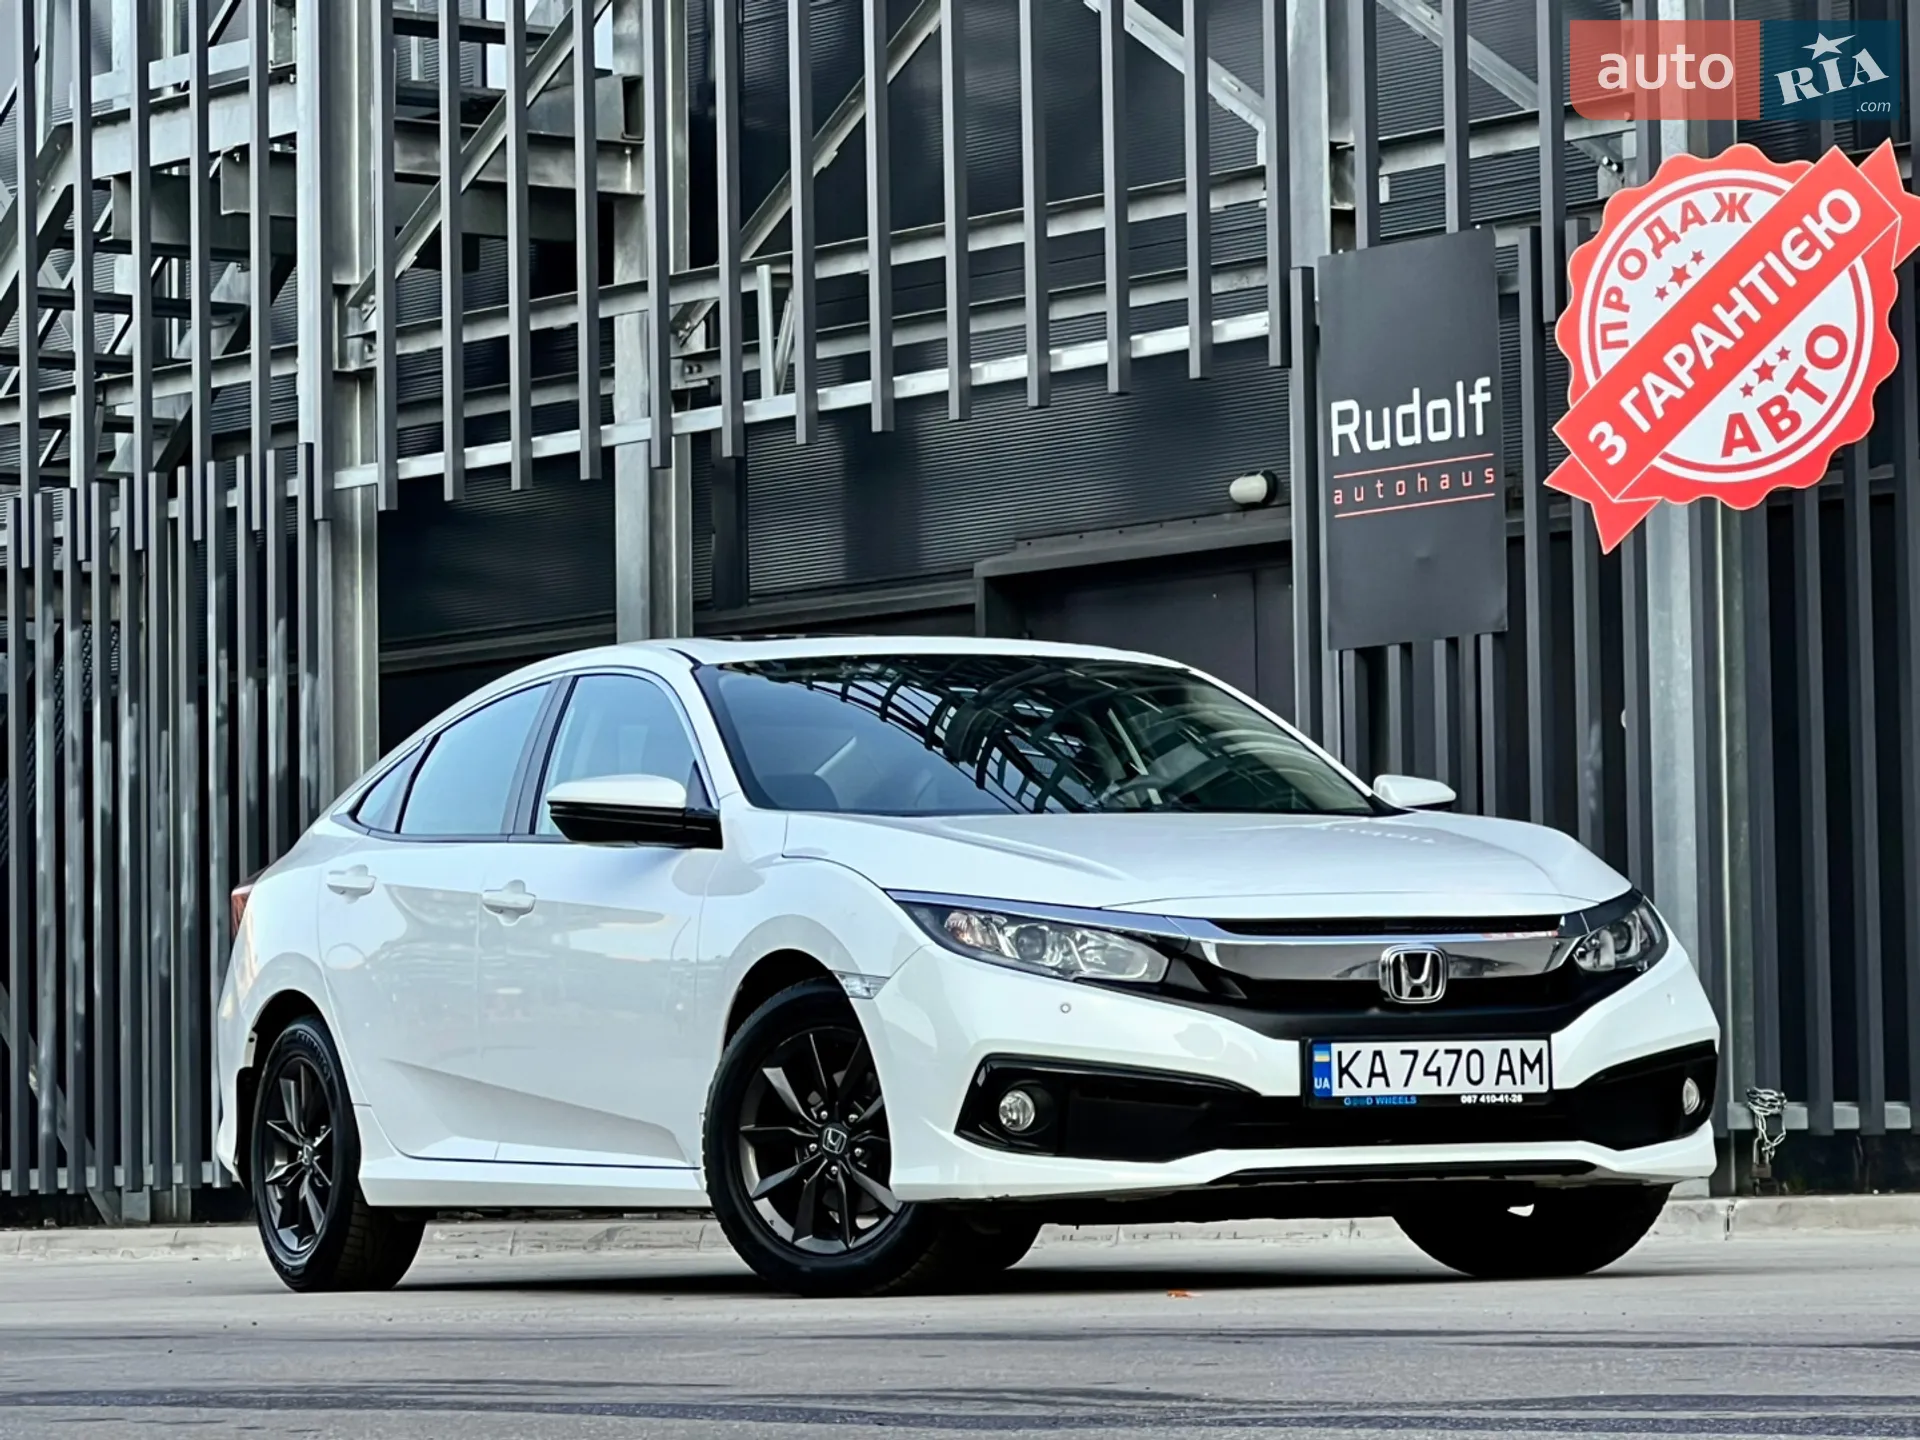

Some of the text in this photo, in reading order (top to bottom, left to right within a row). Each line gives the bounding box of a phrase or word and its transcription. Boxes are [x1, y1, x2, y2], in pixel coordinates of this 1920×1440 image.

[1331, 376, 1491, 457] Rudolf
[1333, 467, 1494, 505] autohaus
[1314, 1077, 1331, 1089] UA
[1337, 1047, 1544, 1089] KA 7470 AM
